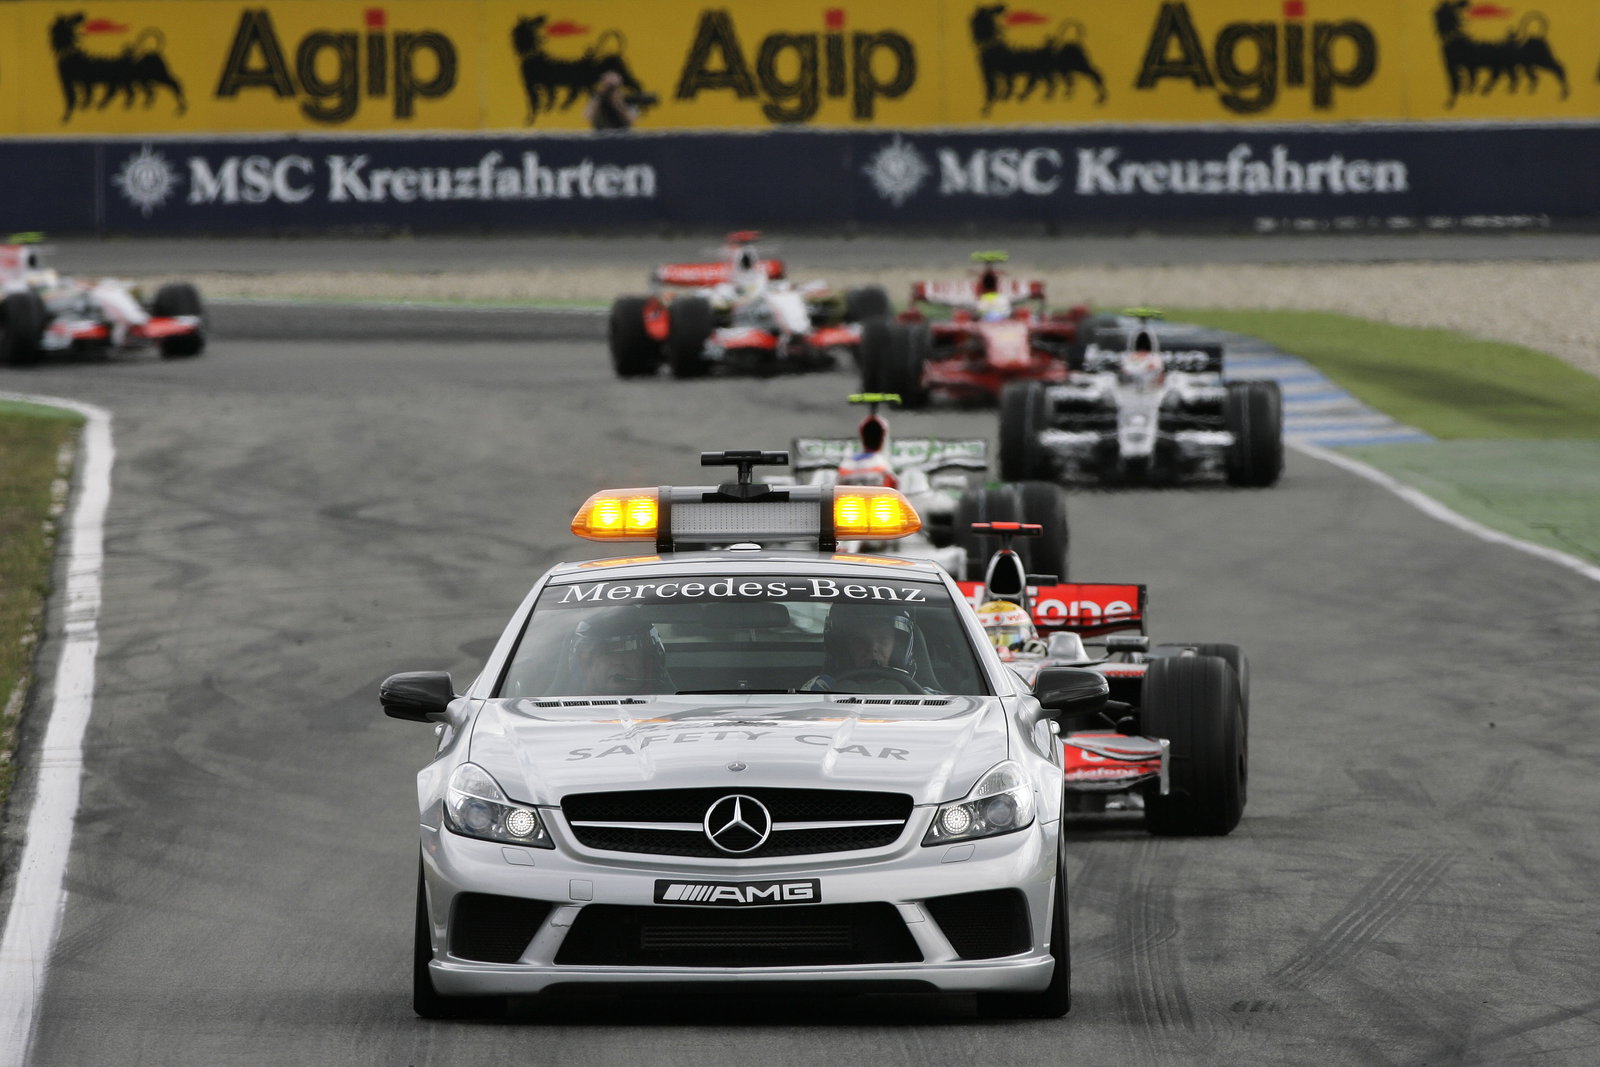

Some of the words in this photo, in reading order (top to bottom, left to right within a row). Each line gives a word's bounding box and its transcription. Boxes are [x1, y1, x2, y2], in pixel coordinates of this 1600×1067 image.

[215, 8, 458, 123] Agip
[675, 8, 917, 123] Agip
[1135, 0, 1380, 115] Agip
[187, 154, 314, 205] MSC
[326, 151, 656, 203] Kreuzfahrten
[937, 146, 1064, 197] MSC
[1075, 144, 1409, 195] Kreuzfahrten
[557, 577, 927, 604] Mercedes-Benz
[565, 730, 774, 762] SAFETY
[794, 734, 911, 762] CAR
[709, 882, 814, 903] AMG
